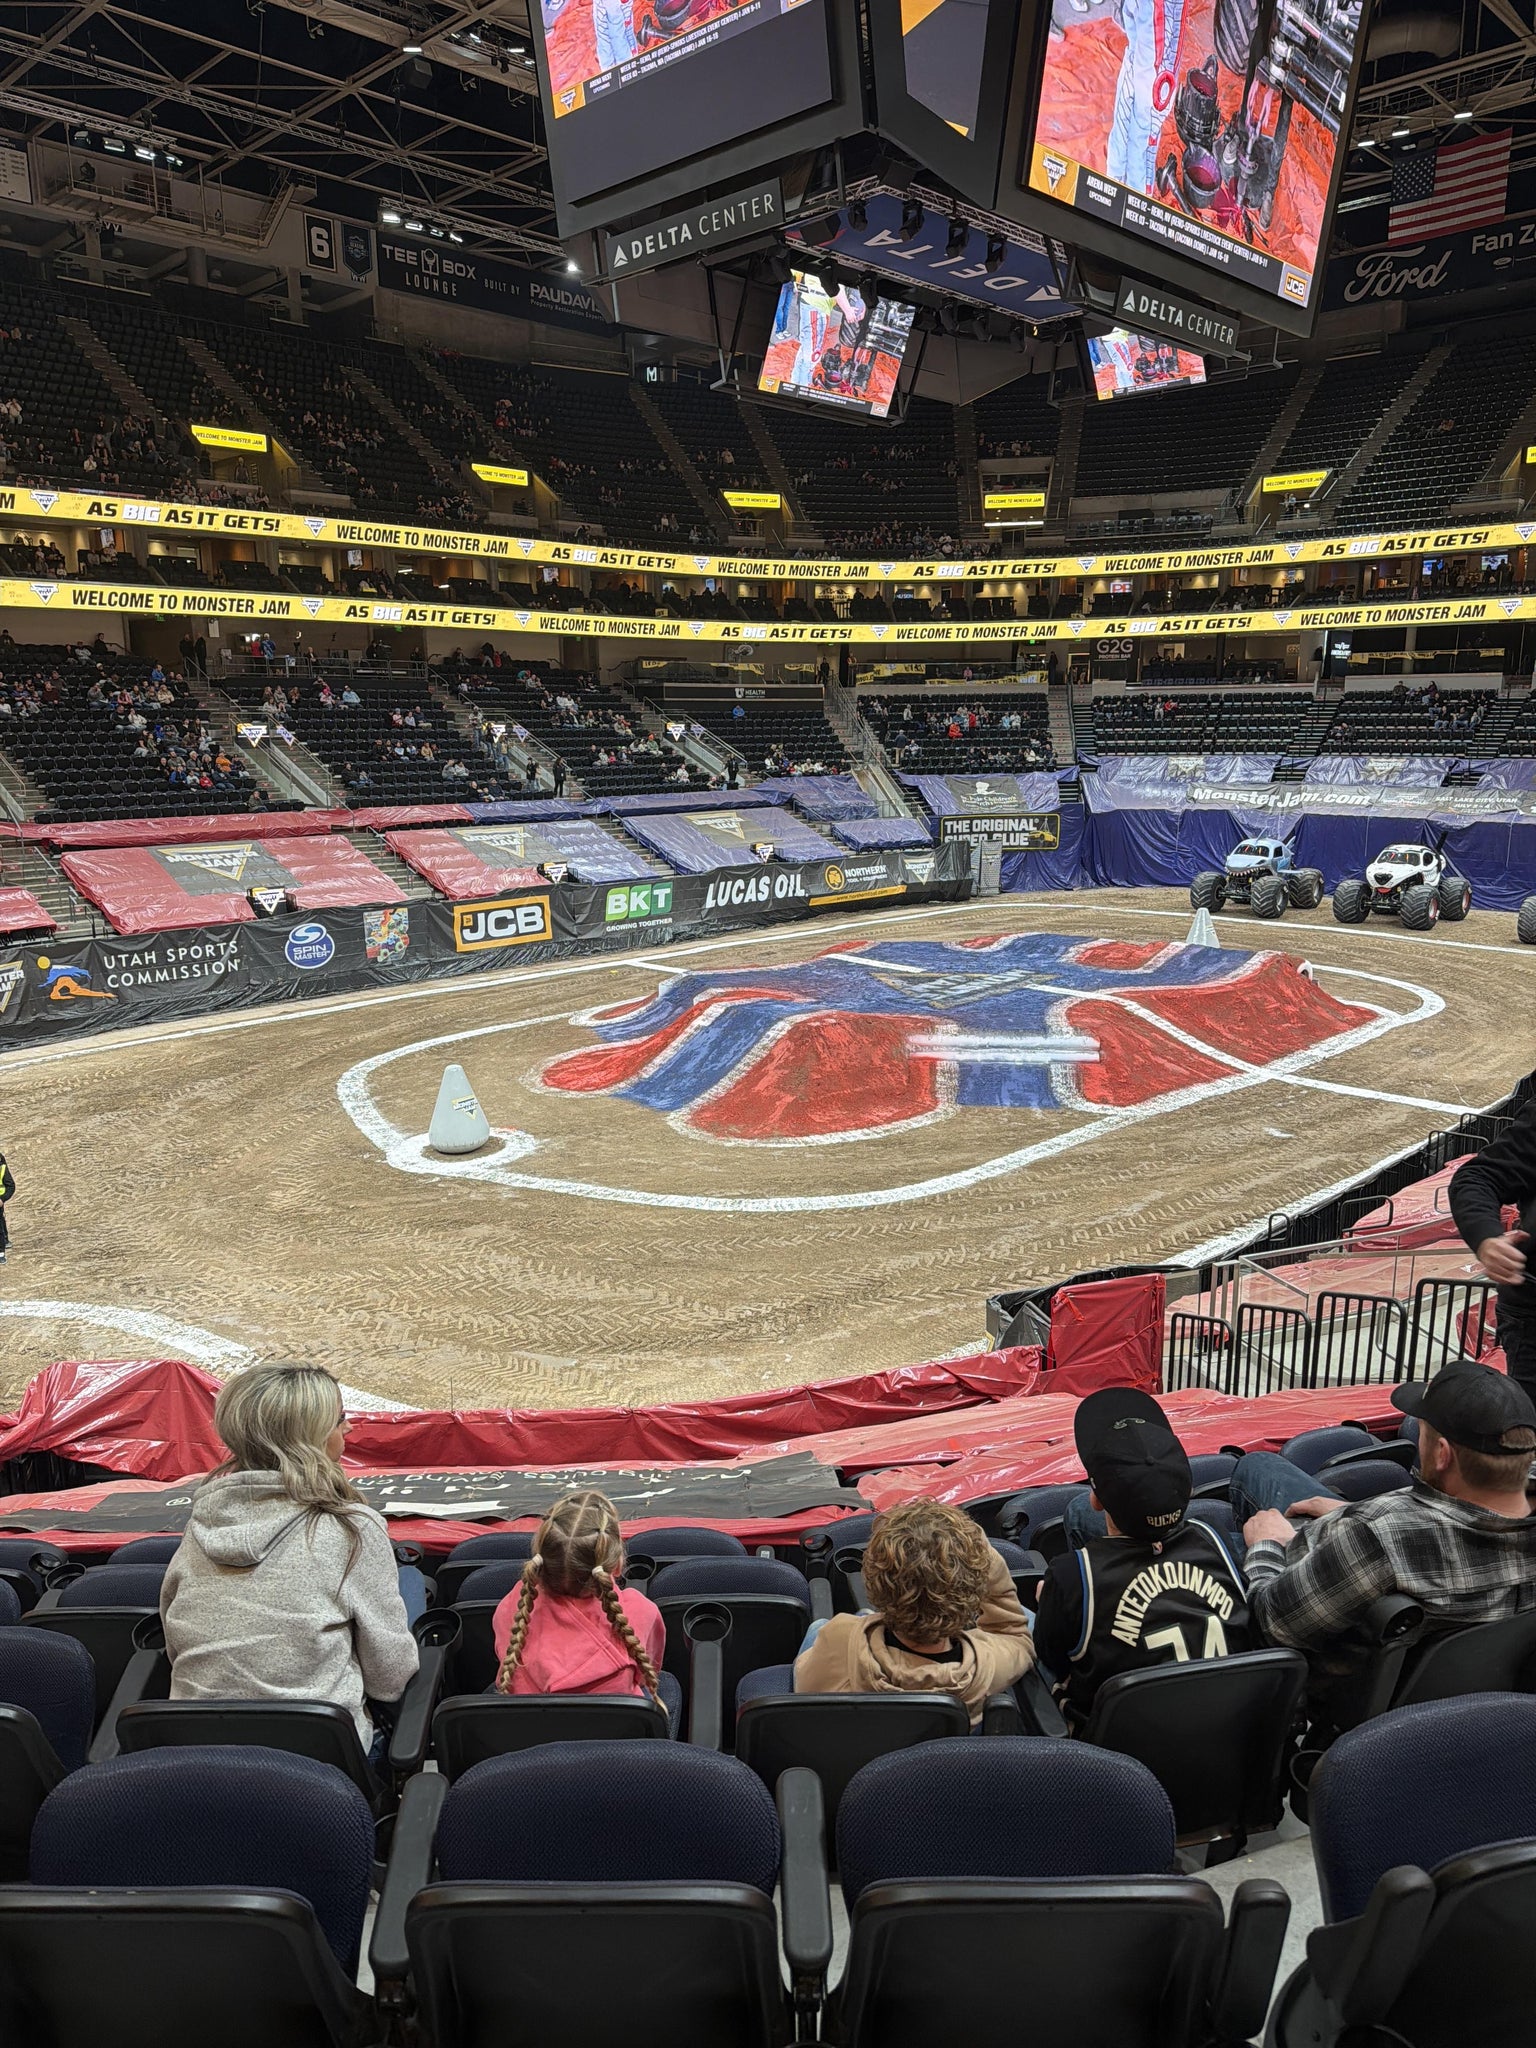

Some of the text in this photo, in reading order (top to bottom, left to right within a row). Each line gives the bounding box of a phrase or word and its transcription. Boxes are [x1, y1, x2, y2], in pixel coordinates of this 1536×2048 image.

[1087, 175, 1117, 198] ARENA WEST
[1089, 190, 1112, 207] UPCOMING
[631, 193, 775, 260] DELTA CENTER
[1126, 208, 1139, 223] WEEK
[1209, 247, 1217, 258] JAN
[1128, 194, 1141, 209] WEEK
[1140, 201, 1147, 212] 02
[1164, 211, 1171, 222] NV
[1221, 237, 1234, 251] EVENT
[1251, 253, 1259, 264] JAN
[1259, 257, 1268, 267] 9-11
[310, 226, 330, 259] 6
[1471, 232, 1513, 254] Fan
[382, 244, 476, 280] TEE BOX
[864, 229, 1030, 290] DELTA
[405, 272, 457, 297] LOUNGE
[1343, 245, 1452, 303] Ford
[484, 279, 520, 295] BUILT BY
[1287, 278, 1304, 295] JCB
[1139, 295, 1234, 345] DELTA CENTER
[87, 501, 118, 517] AS
[122, 504, 161, 522] BIG
[165, 509, 193, 524] AS
[197, 512, 219, 526] IT
[223, 514, 280, 531] GETS!
[337, 525, 400, 544] WELCOME
[405, 532, 419, 546] TO
[423, 534, 480, 552] MONSTER
[483, 540, 509, 554] JAM
[552, 547, 570, 560] AS
[573, 548, 598, 563] BIG
[600, 552, 617, 564] AS
[620, 554, 634, 566] IT
[638, 556, 676, 569] GETS!
[718, 561, 769, 575] WELCOME
[773, 563, 786, 576] TO
[789, 564, 840, 578] MONSTER
[844, 566, 869, 578] JAM
[913, 566, 934, 577] AS
[937, 565, 964, 577] BIG
[967, 565, 988, 576] AS
[991, 564, 1008, 575] IT
[1011, 562, 1057, 575] GETS!
[1105, 557, 1162, 571] WELCOME
[1167, 555, 1181, 568] TO
[1185, 551, 1243, 567] MONSTER
[1246, 549, 1274, 563] JAM
[1322, 543, 1345, 556] AS
[1348, 540, 1380, 555] BIG
[1382, 538, 1408, 551] AS
[1410, 536, 1431, 549] IT
[1433, 532, 1490, 547] GETS!
[72, 589, 154, 609] WELCOME
[159, 594, 178, 609] TO
[183, 595, 254, 613] MONSTER
[259, 601, 290, 616] JAM
[345, 605, 369, 618] AS
[372, 606, 402, 621] BIG
[405, 609, 427, 621] AS
[431, 610, 448, 622] IT
[452, 611, 496, 625] GETS!
[540, 617, 590, 632] WELCOME
[593, 620, 605, 633] TO
[608, 621, 655, 635] MONSTER
[659, 624, 681, 637] JAM
[721, 627, 740, 637] AS
[743, 626, 767, 639] BIG
[769, 628, 788, 639] AS
[791, 628, 807, 639] IT
[810, 628, 852, 639] GETS!
[896, 627, 951, 640] WELCOME
[956, 627, 969, 639] TO
[972, 626, 1028, 638] MONSTER
[1031, 625, 1058, 637] JAM
[1104, 623, 1126, 633] AS
[1129, 621, 1158, 633] BIG
[1160, 620, 1182, 631] AS
[1184, 619, 1202, 630] IT
[1205, 617, 1252, 629] GETS!
[1300, 610, 1362, 626] WELCOME
[1366, 609, 1381, 622] TO
[1384, 606, 1450, 622] MONSTER
[1454, 605, 1486, 618] JAM
[1097, 638, 1134, 654] G2G
[1193, 788, 1371, 808] MonsterJam.com
[462, 832, 532, 842] MONSTER
[945, 818, 1037, 834] THE ORIGINAL
[945, 833, 1029, 847] SUPER GLUE
[166, 851, 260, 863] MONSTER
[200, 859, 242, 868] JAM
[844, 864, 887, 878] NORTHERN
[607, 887, 671, 915] BKT
[705, 876, 770, 909] LUCAS
[462, 905, 544, 941] JCB
[606, 917, 673, 932] GROWING TOGETHER
[104, 940, 238, 970] UTAH SPORTS
[292, 943, 327, 955] SPIN
[294, 951, 328, 961] MASTER
[107, 959, 240, 988] COMMISSION
[1146, 1508, 1182, 1528] BUCKS
[1111, 1561, 1234, 1648] ANTETOKOUNMPO
